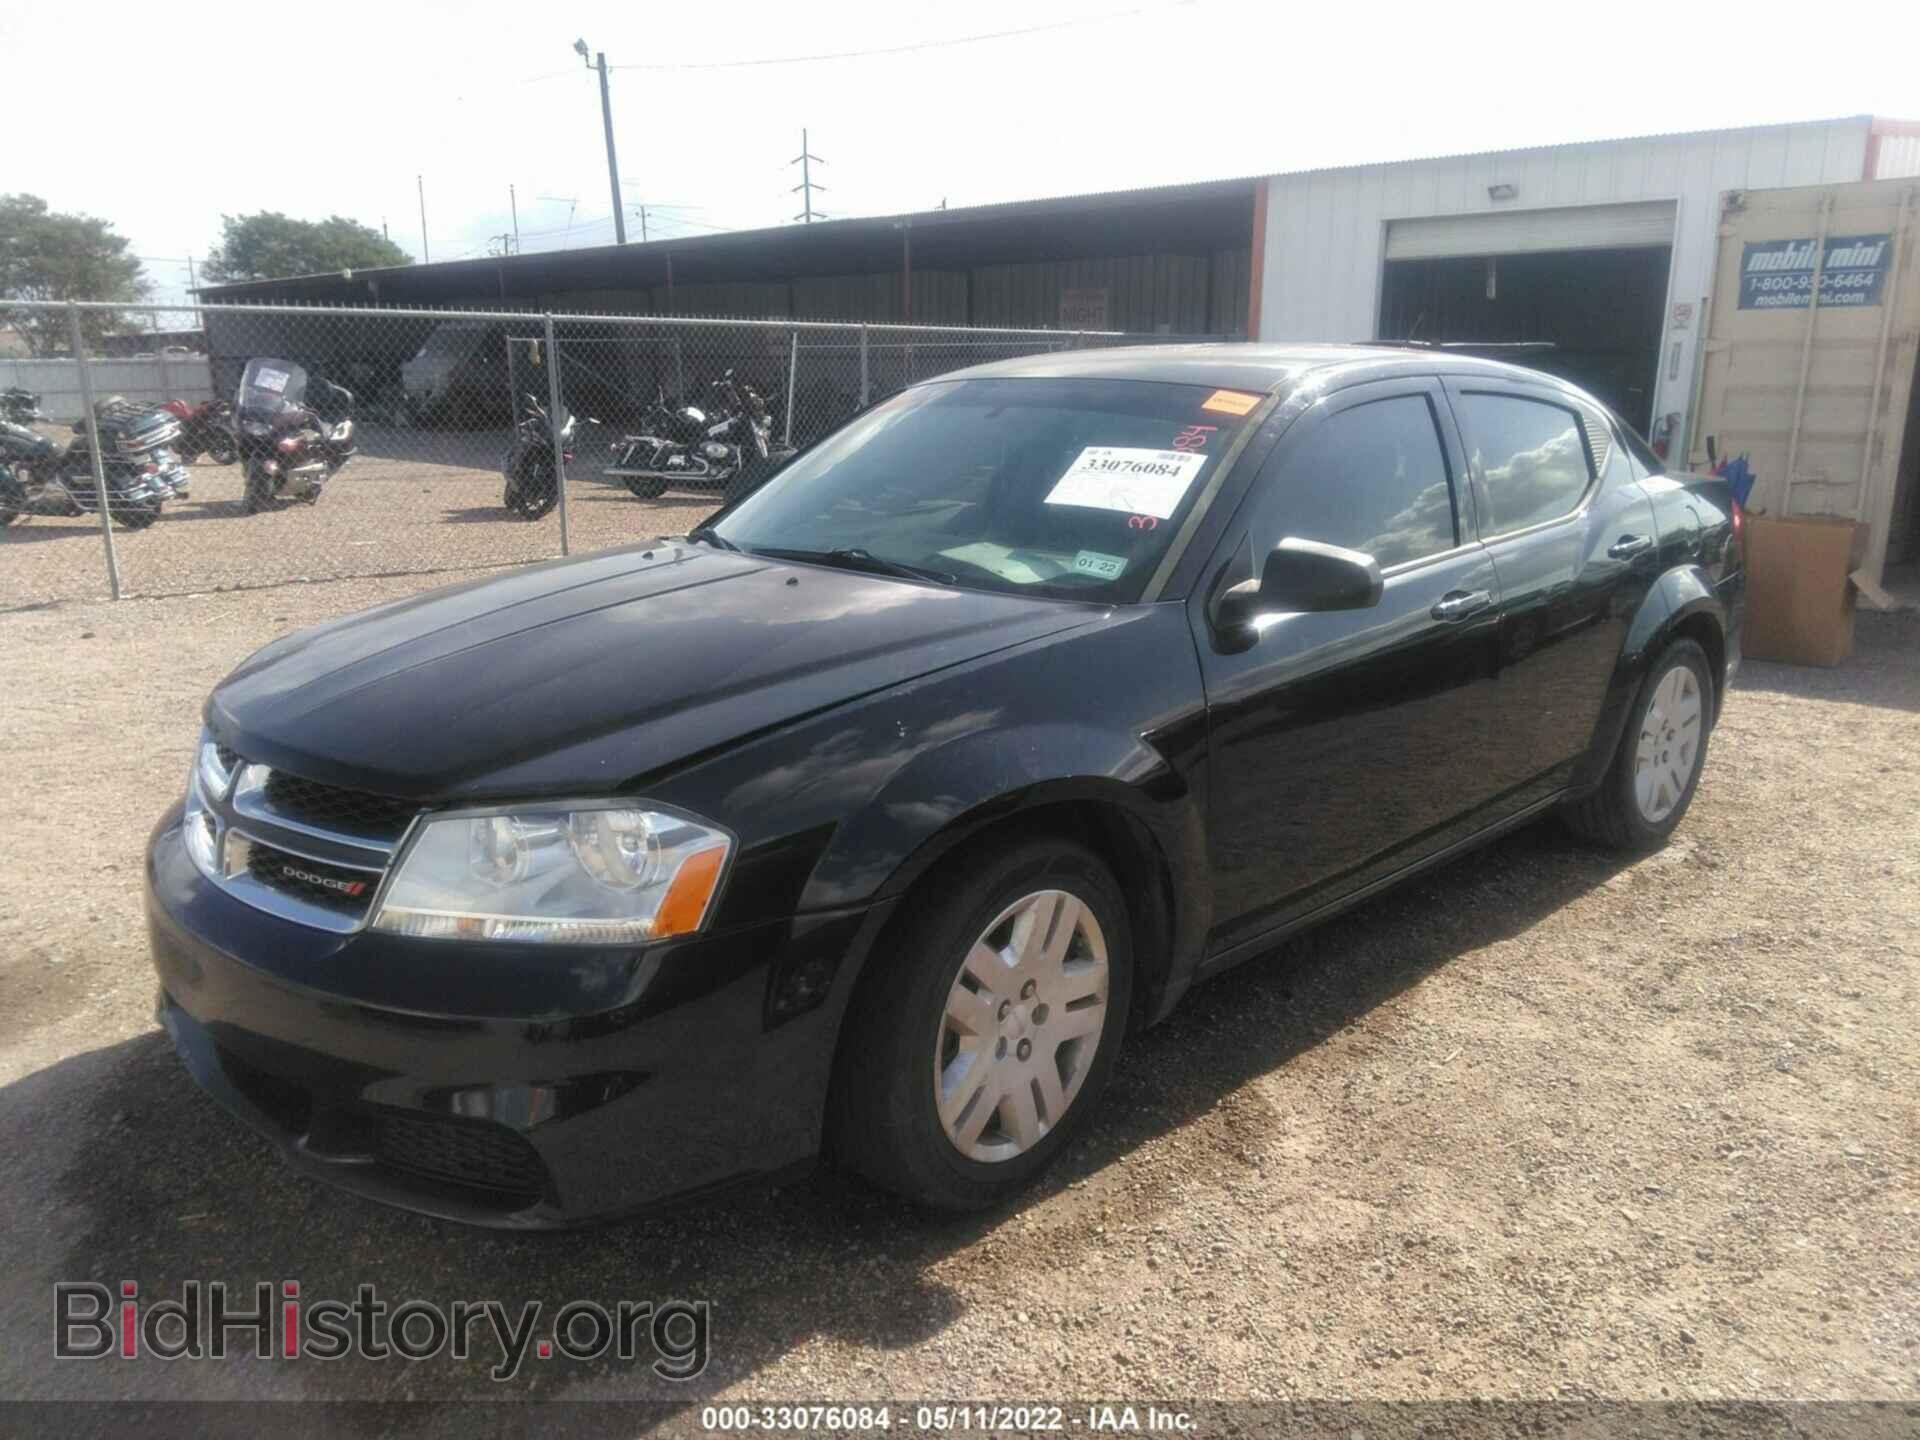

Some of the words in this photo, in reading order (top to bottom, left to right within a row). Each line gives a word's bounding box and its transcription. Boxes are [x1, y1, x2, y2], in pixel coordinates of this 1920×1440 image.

[1747, 241, 1819, 271] mobil
[1827, 240, 1885, 268] mini
[1081, 458, 1182, 477] 33076084
[1078, 558, 1094, 568] 01
[1098, 562, 1116, 572] 22
[283, 866, 349, 891] DODGE
